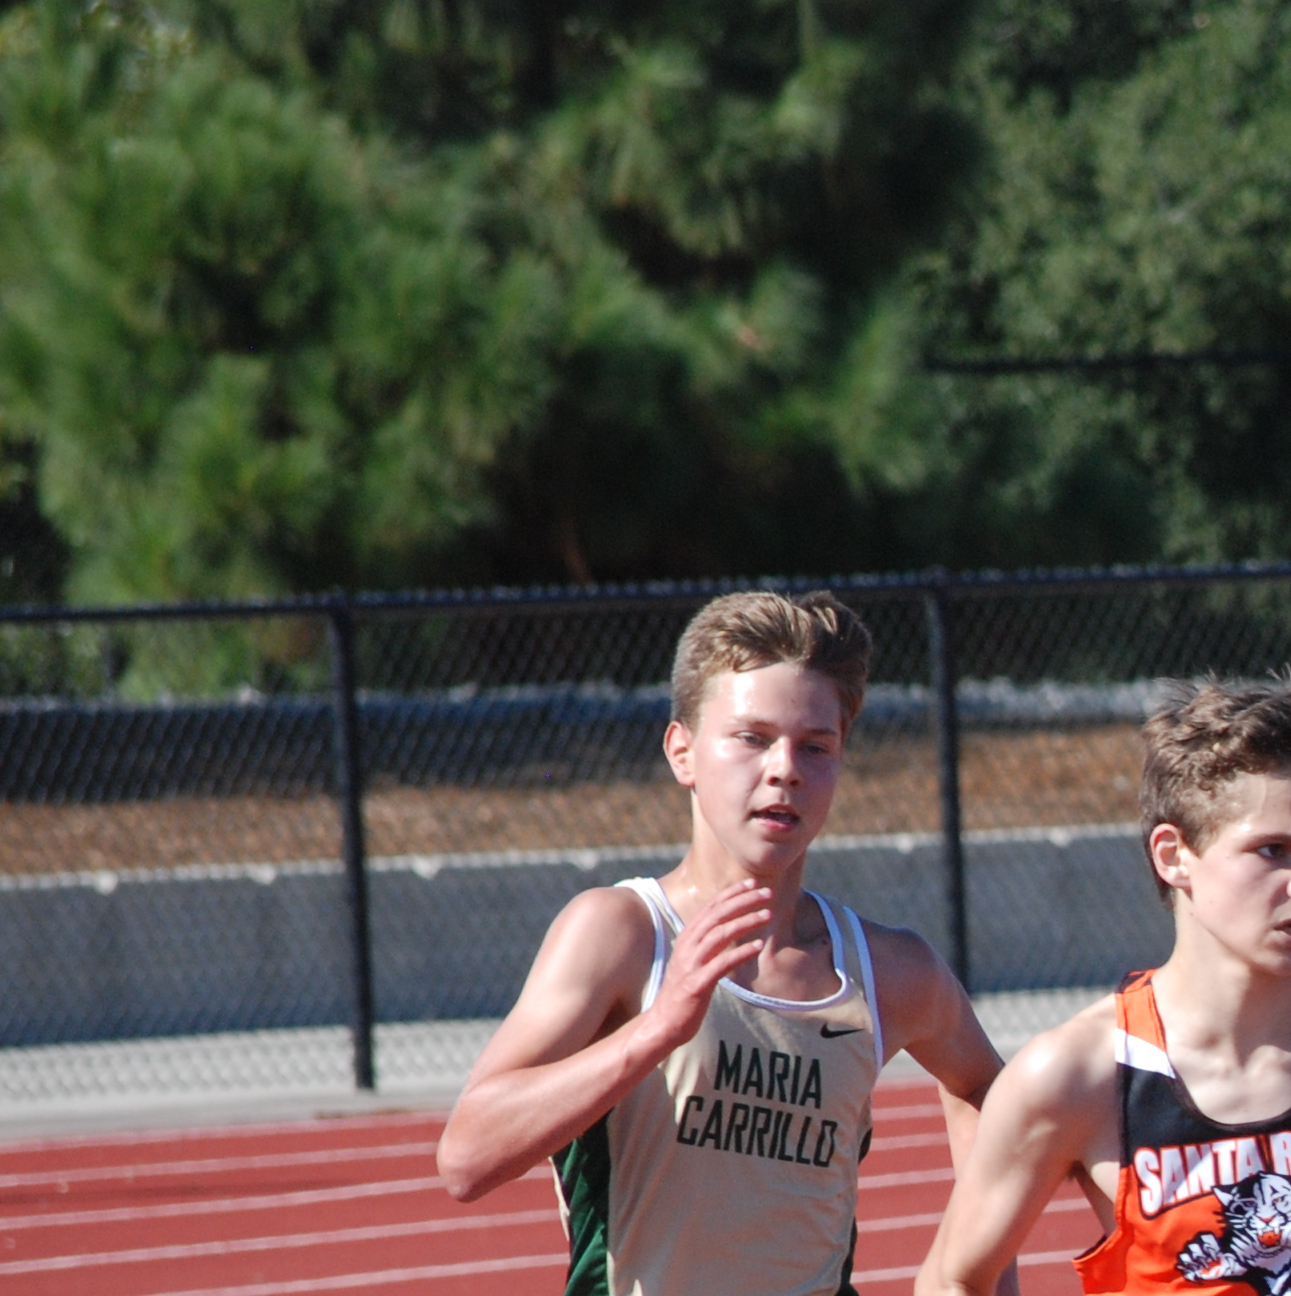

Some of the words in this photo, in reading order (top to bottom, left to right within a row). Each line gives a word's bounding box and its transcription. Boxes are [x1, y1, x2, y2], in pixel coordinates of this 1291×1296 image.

[713, 1040, 822, 1109] MARIA
[676, 1095, 838, 1168] CARRILLO
[1134, 1136, 1266, 1215] SANTA
